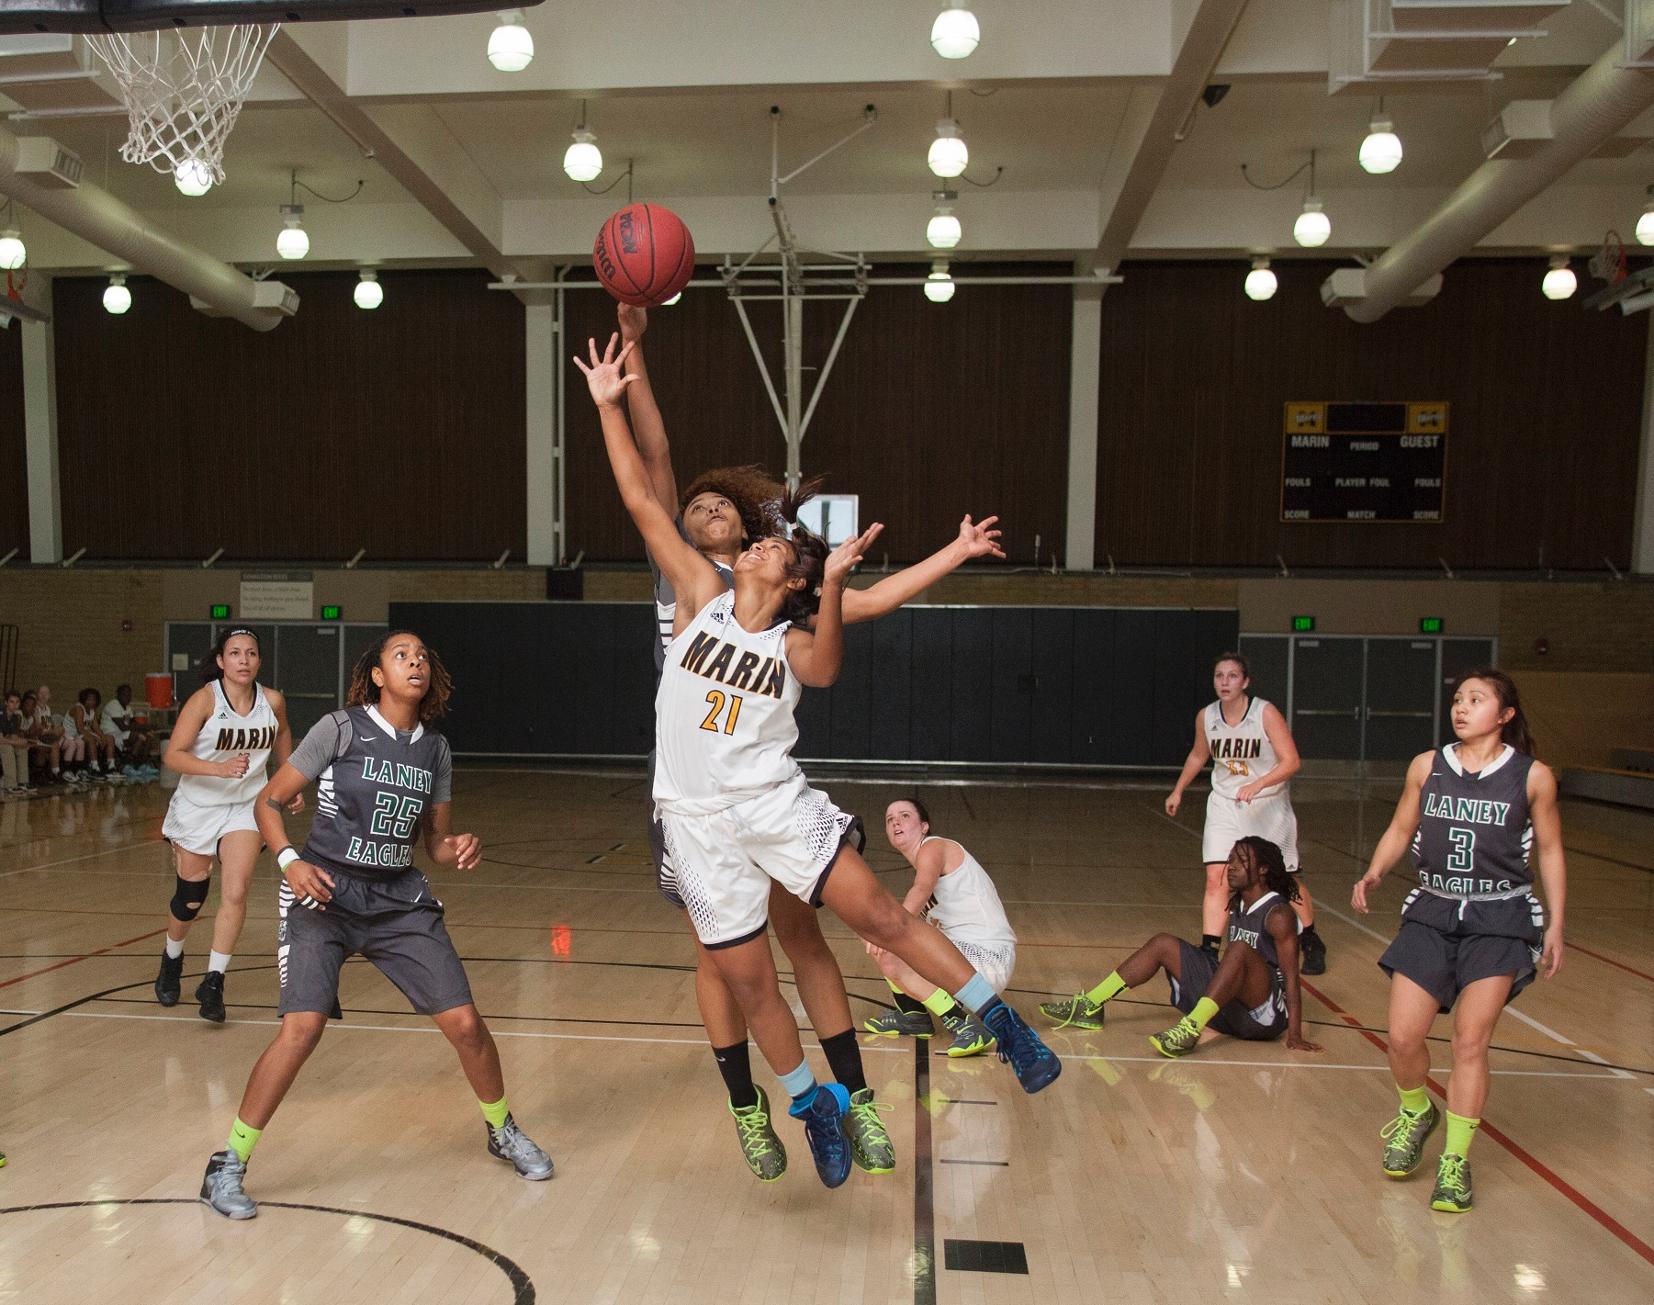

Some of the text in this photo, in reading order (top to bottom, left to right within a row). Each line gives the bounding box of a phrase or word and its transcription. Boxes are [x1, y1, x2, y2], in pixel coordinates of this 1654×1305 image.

[1291, 435, 1330, 448] MARIN
[1349, 441, 1380, 451] PERIOD
[1400, 435, 1440, 448] GUEST
[1285, 478, 1311, 487] FOULS
[1335, 478, 1390, 487] PLAYER FOUL
[1414, 478, 1441, 488] FOULS
[1284, 510, 1310, 519] SCORE
[1347, 510, 1376, 519] MATCH
[1413, 510, 1440, 520] SCORE
[213, 606, 227, 617] EXIT
[324, 607, 337, 618] EXIT
[1295, 618, 1311, 630] EXIT
[1423, 619, 1440, 631] EXIT
[680, 631, 786, 699] MARIN
[699, 690, 744, 736] 21
[215, 725, 276, 751] MARIN
[1210, 738, 1261, 759] MARIN
[361, 756, 433, 794] LANEY
[370, 791, 423, 839] 25
[1423, 793, 1510, 826] LANEY
[1446, 827, 1476, 872] 3
